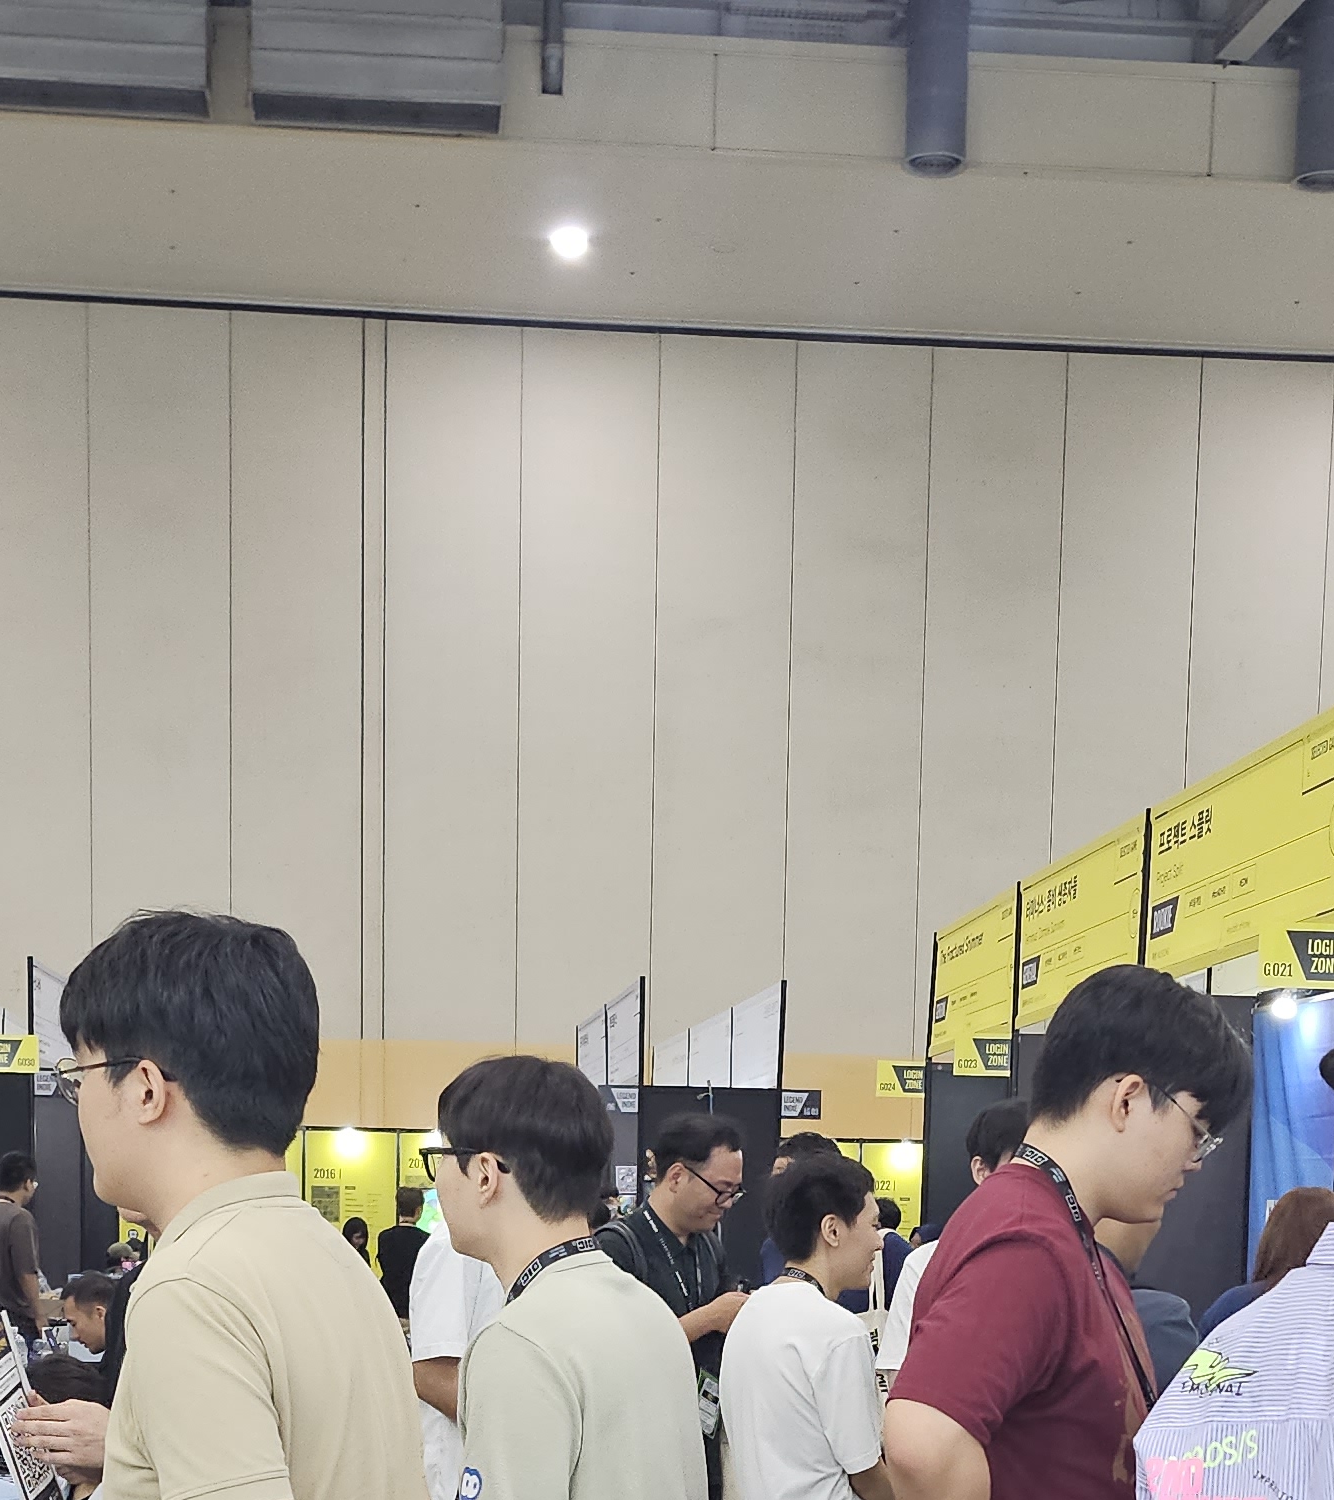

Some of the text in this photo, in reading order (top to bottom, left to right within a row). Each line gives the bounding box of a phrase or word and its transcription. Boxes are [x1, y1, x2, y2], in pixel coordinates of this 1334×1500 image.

[1158, 804, 1214, 856] 프로젝트 스플릿
[1153, 904, 1174, 933] ROOKIE
[1263, 962, 1293, 977] G021
[986, 1043, 1009, 1054] LOGIN
[957, 1059, 978, 1069] G023
[987, 1055, 1009, 1066] ZONE
[903, 1069, 923, 1080] LOGIN
[879, 1083, 896, 1091] G024
[904, 1080, 923, 1090] ZONE
[783, 1096, 804, 1104] LEGEND
[408, 1158, 425, 1169] 20
[313, 1168, 336, 1180] 2016
[874, 1180, 891, 1191] 022
